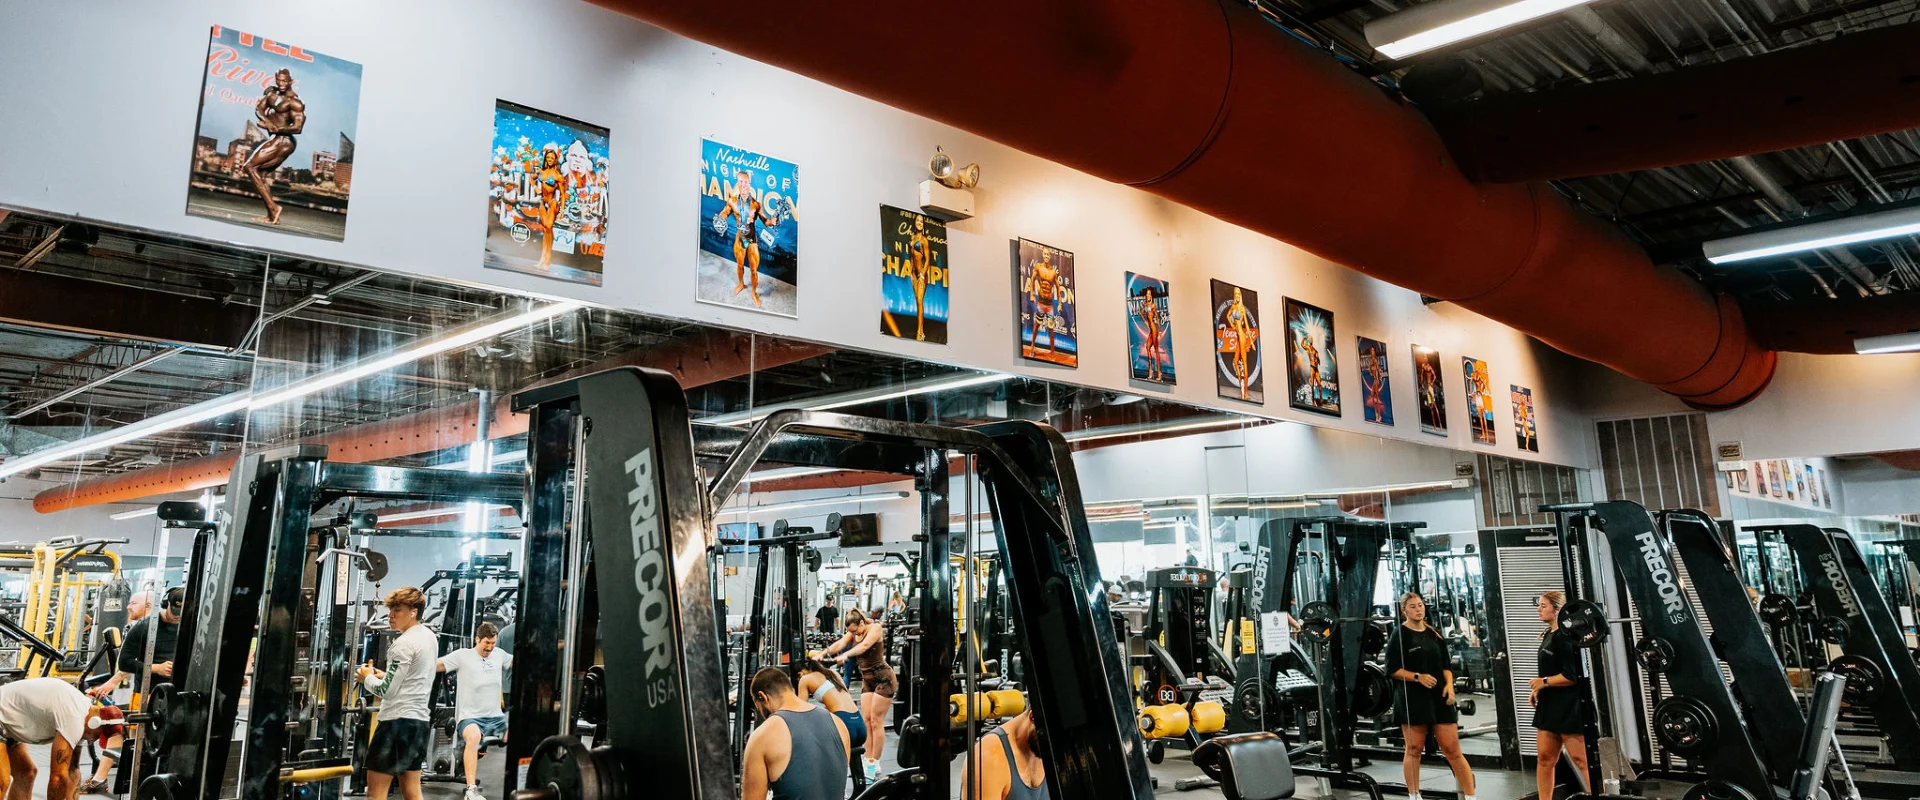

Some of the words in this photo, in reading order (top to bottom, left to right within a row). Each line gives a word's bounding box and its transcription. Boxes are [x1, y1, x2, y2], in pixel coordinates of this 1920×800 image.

[716, 147, 770, 172] Nashville
[766, 174, 791, 192] OF
[895, 241, 939, 261] NIT
[625, 447, 672, 679] PRECOR
[1635, 531, 1684, 615] PRECOR
[1669, 612, 1690, 625] USA
[1001, 648, 1009, 683] PRECO
[646, 678, 678, 709] USA
